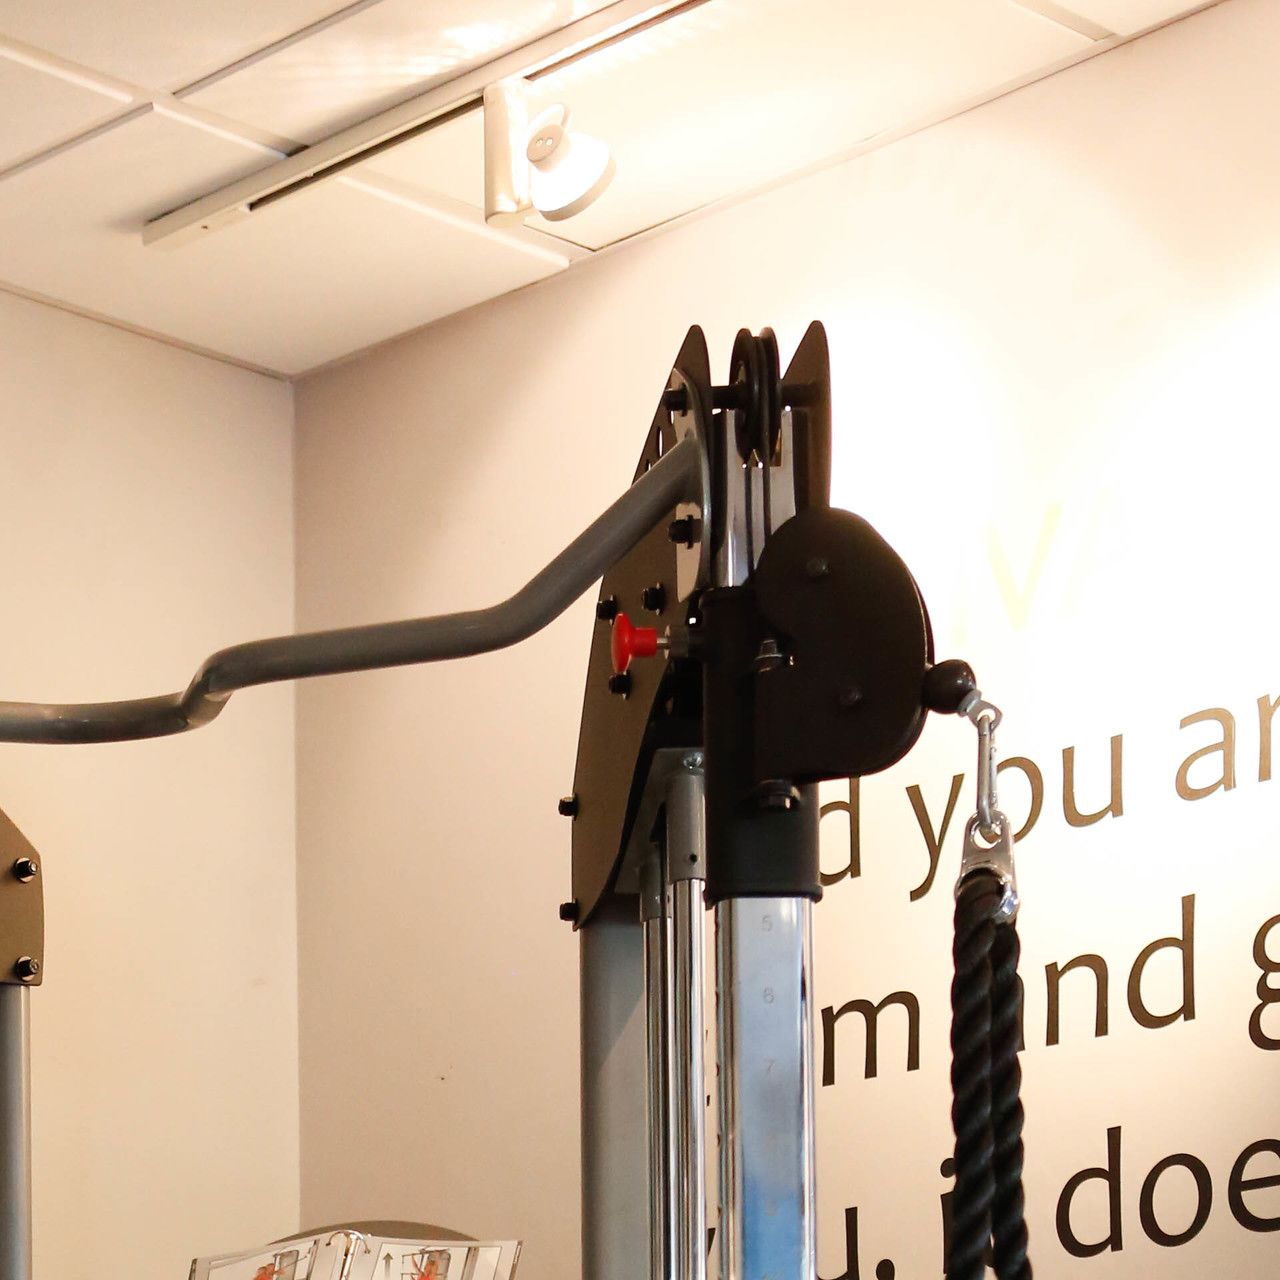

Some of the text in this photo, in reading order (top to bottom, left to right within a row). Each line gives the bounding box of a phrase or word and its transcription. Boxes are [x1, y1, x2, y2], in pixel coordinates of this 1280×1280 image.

[906, 735, 1124, 902] you
[821, 990, 920, 1087] m
[1017, 894, 1196, 1052] nd
[1056, 1126, 1280, 1258] doe
